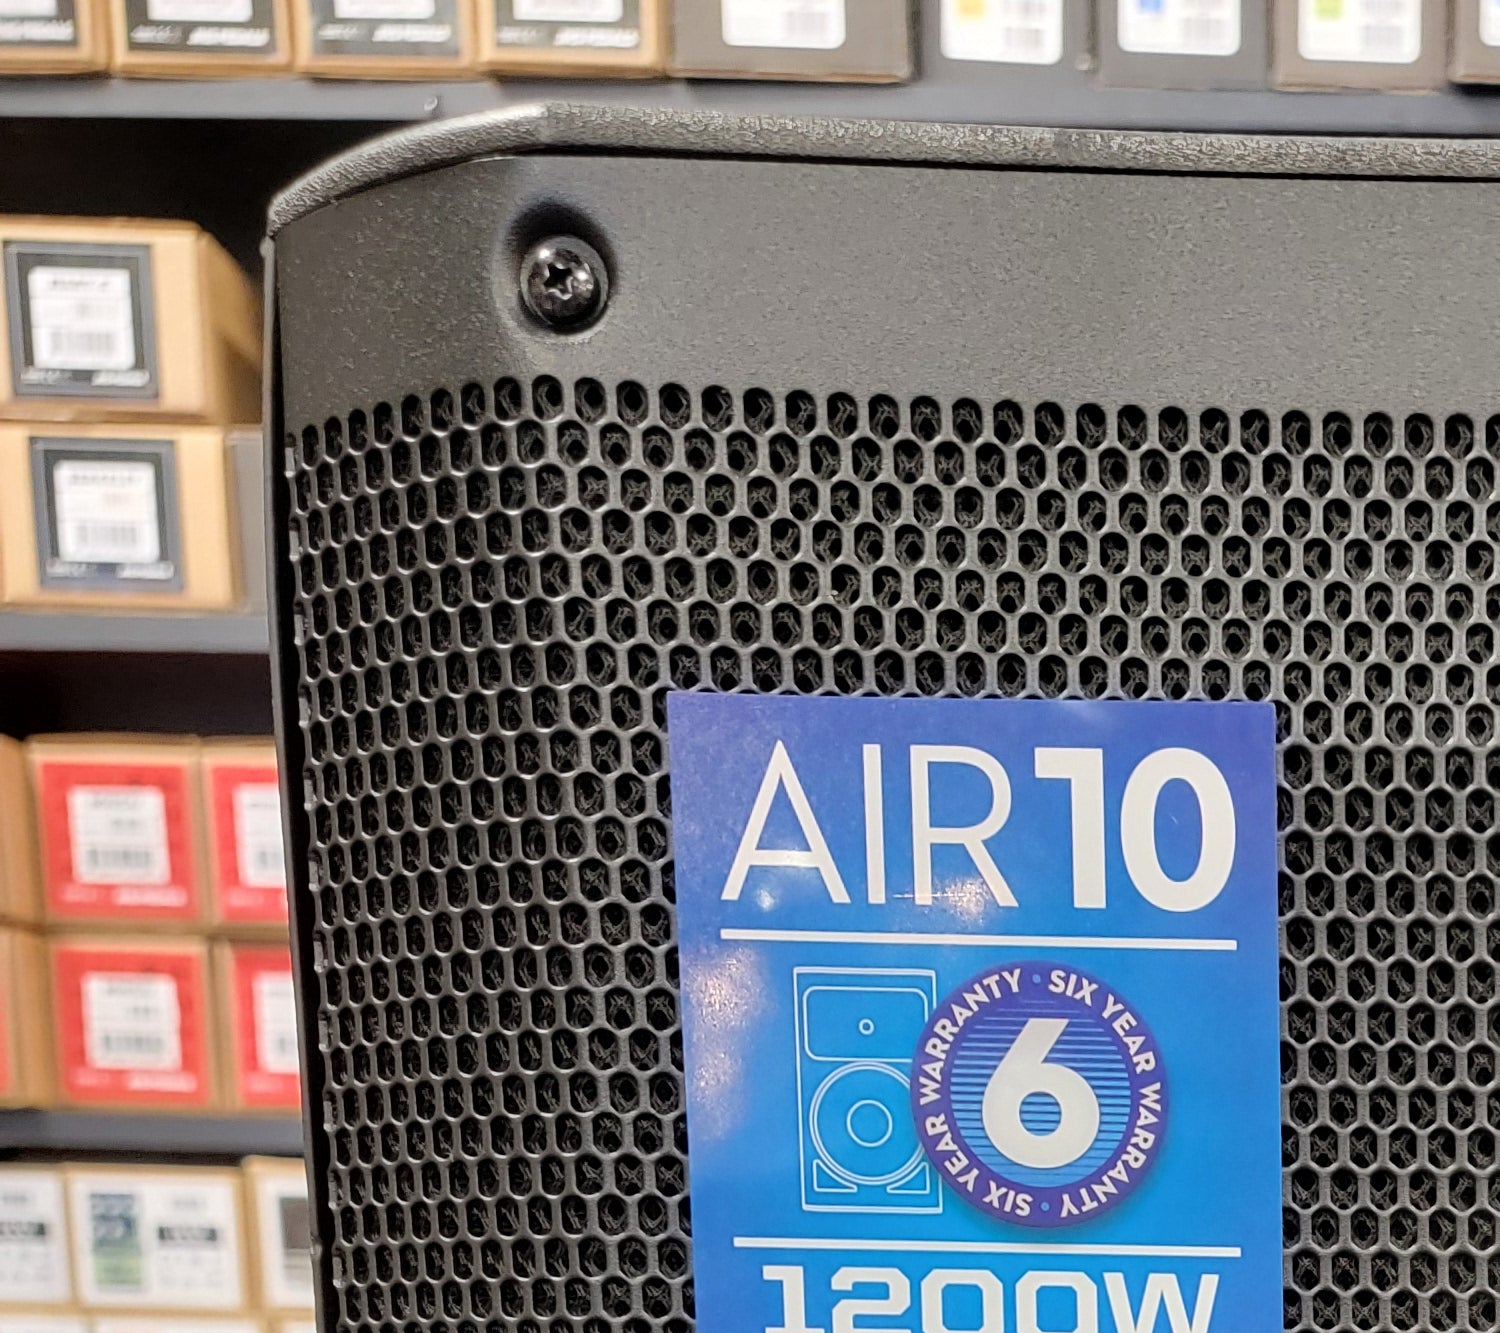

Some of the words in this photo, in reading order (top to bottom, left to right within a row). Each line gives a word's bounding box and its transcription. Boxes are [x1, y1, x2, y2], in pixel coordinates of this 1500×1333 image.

[1048, 969, 1099, 1007] SIX
[919, 968, 1021, 1106] WARRANTY
[1101, 994, 1156, 1074] YEAR
[981, 1017, 1101, 1170] 6
[924, 1113, 979, 1193] YEAR
[1060, 1082, 1162, 1218] WARRANTY
[982, 1180, 1033, 1217] SIX
